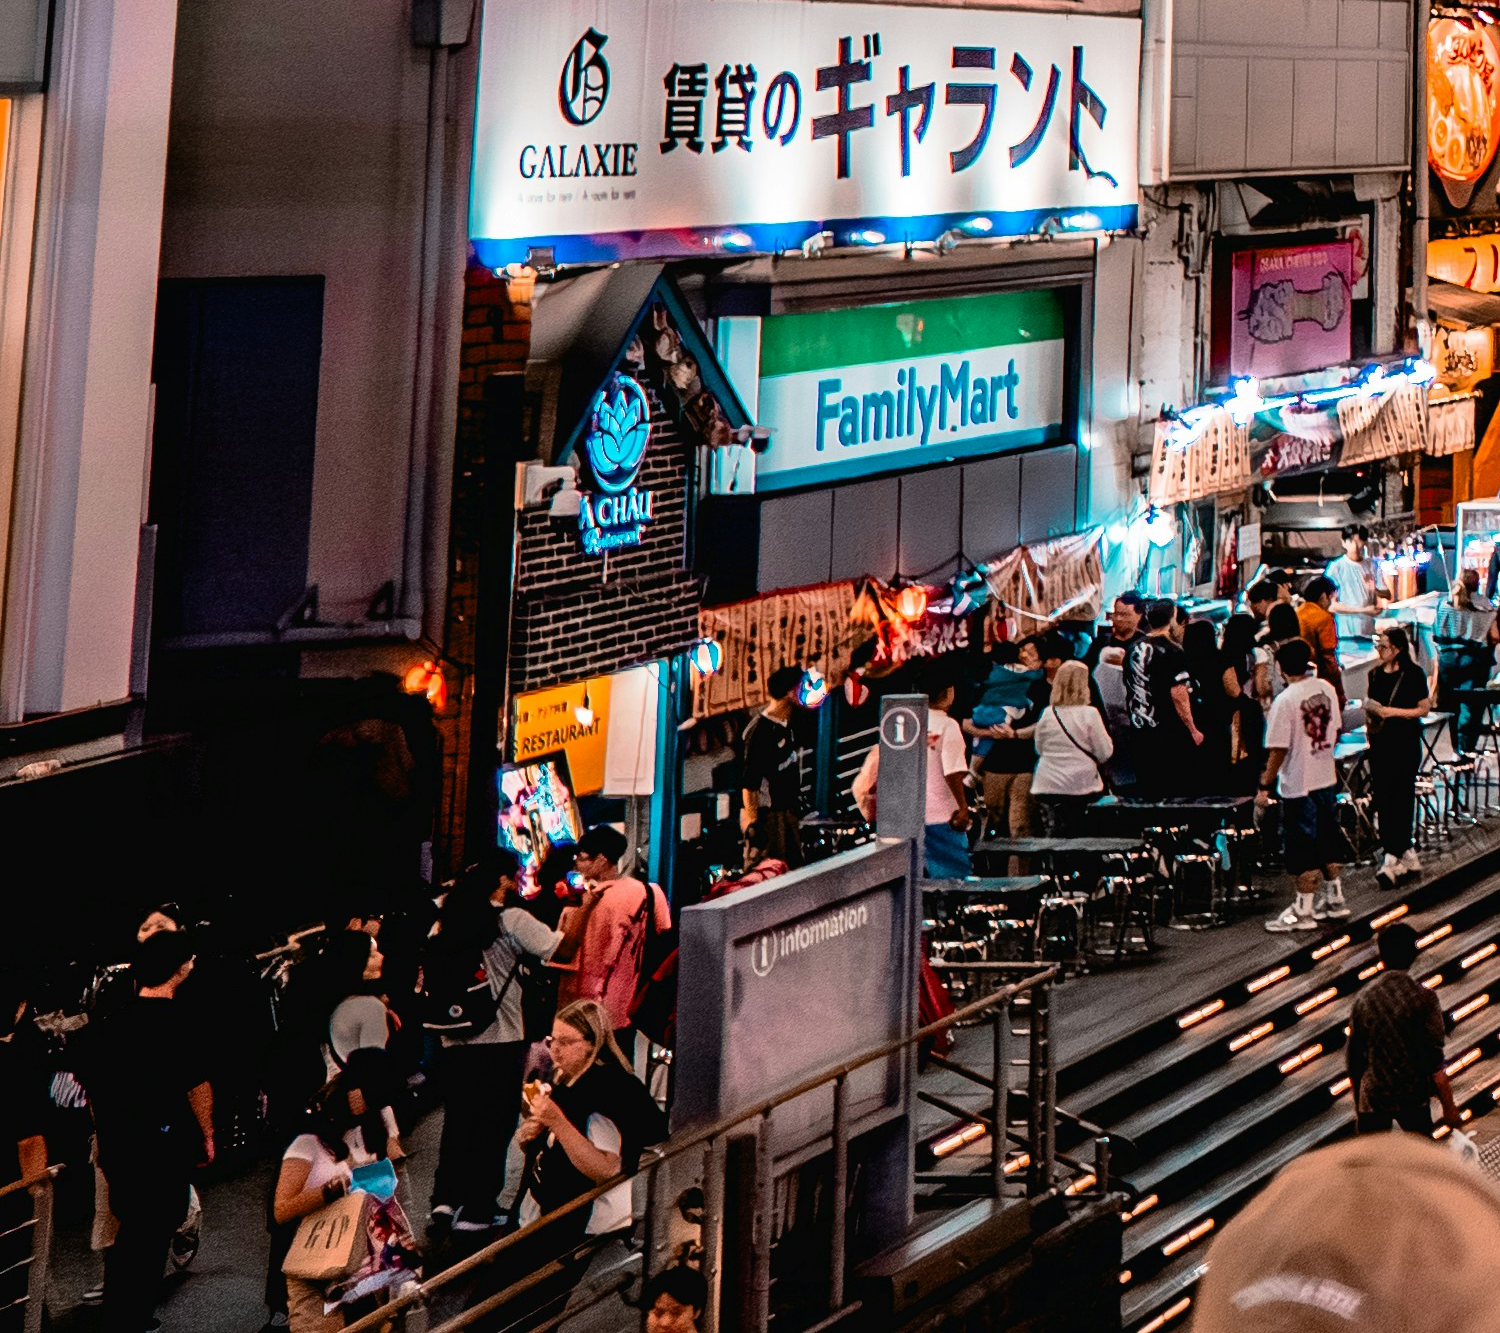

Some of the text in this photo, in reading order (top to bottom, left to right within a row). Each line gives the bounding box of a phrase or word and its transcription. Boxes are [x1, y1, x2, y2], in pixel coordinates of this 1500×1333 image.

[659, 31, 1122, 189] 賃貸のギャラント
[519, 141, 640, 181] GALAXIE
[814, 357, 1021, 453] FamilyMart
[779, 903, 869, 959] information
